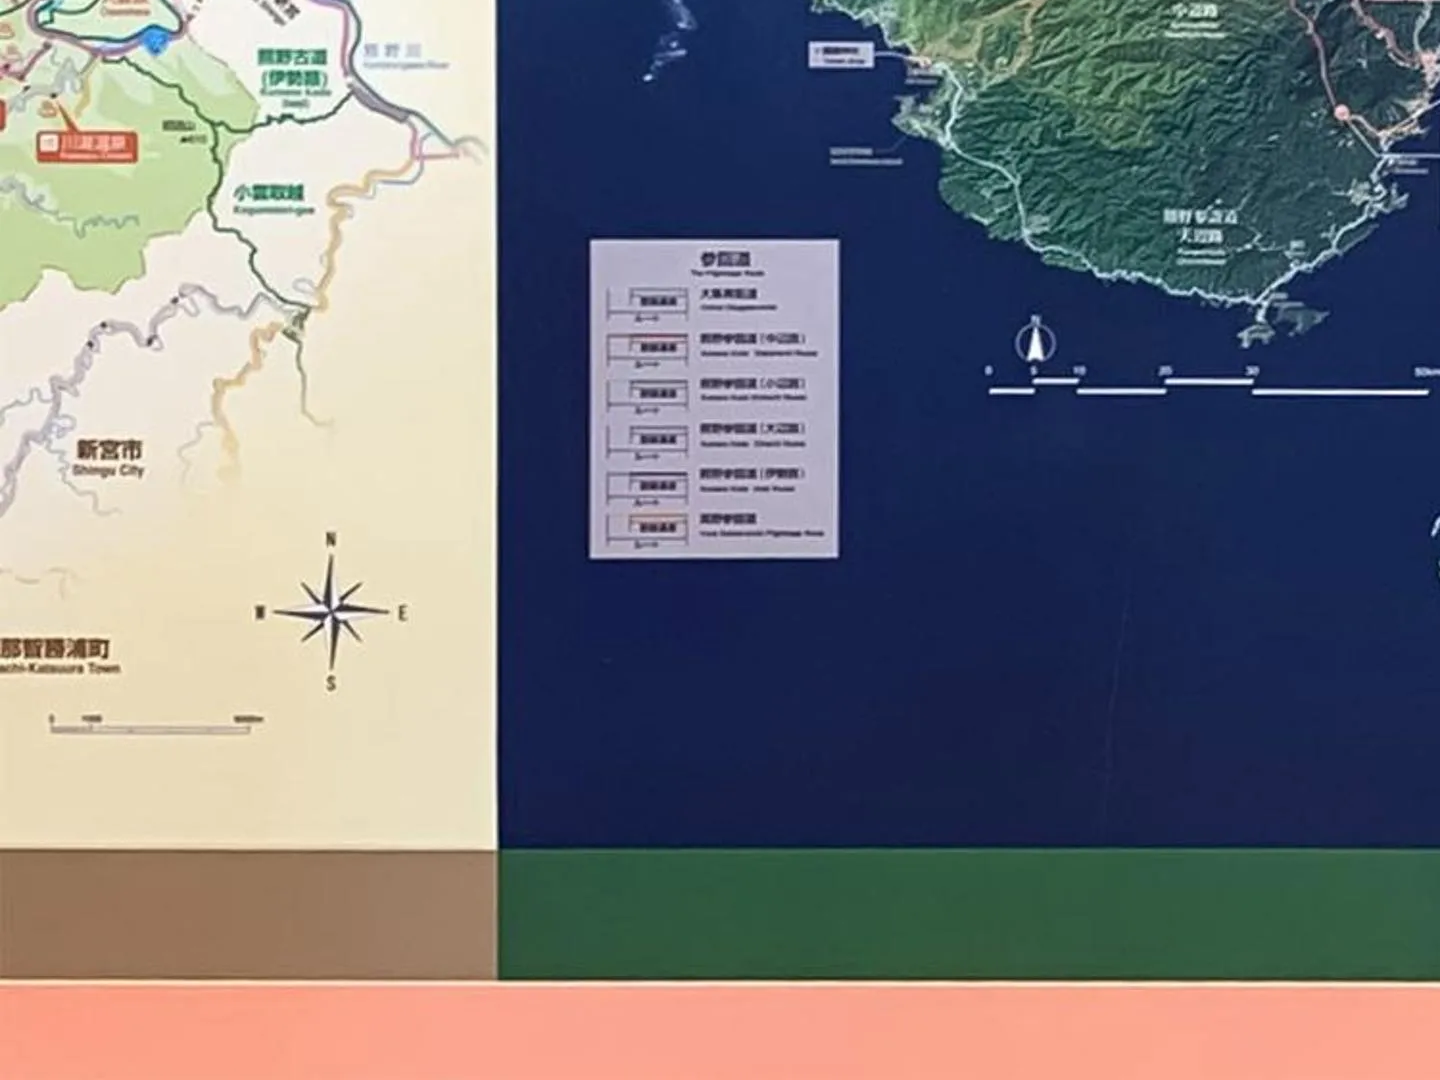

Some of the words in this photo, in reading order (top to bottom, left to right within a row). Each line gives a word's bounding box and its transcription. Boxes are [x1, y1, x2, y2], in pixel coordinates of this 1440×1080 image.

[77, 438, 142, 461] 新宮市
[72, 464, 116, 479] Shingu
[119, 463, 145, 480] City
[325, 531, 337, 548] N
[398, 604, 408, 622] E
[326, 674, 337, 692] S
